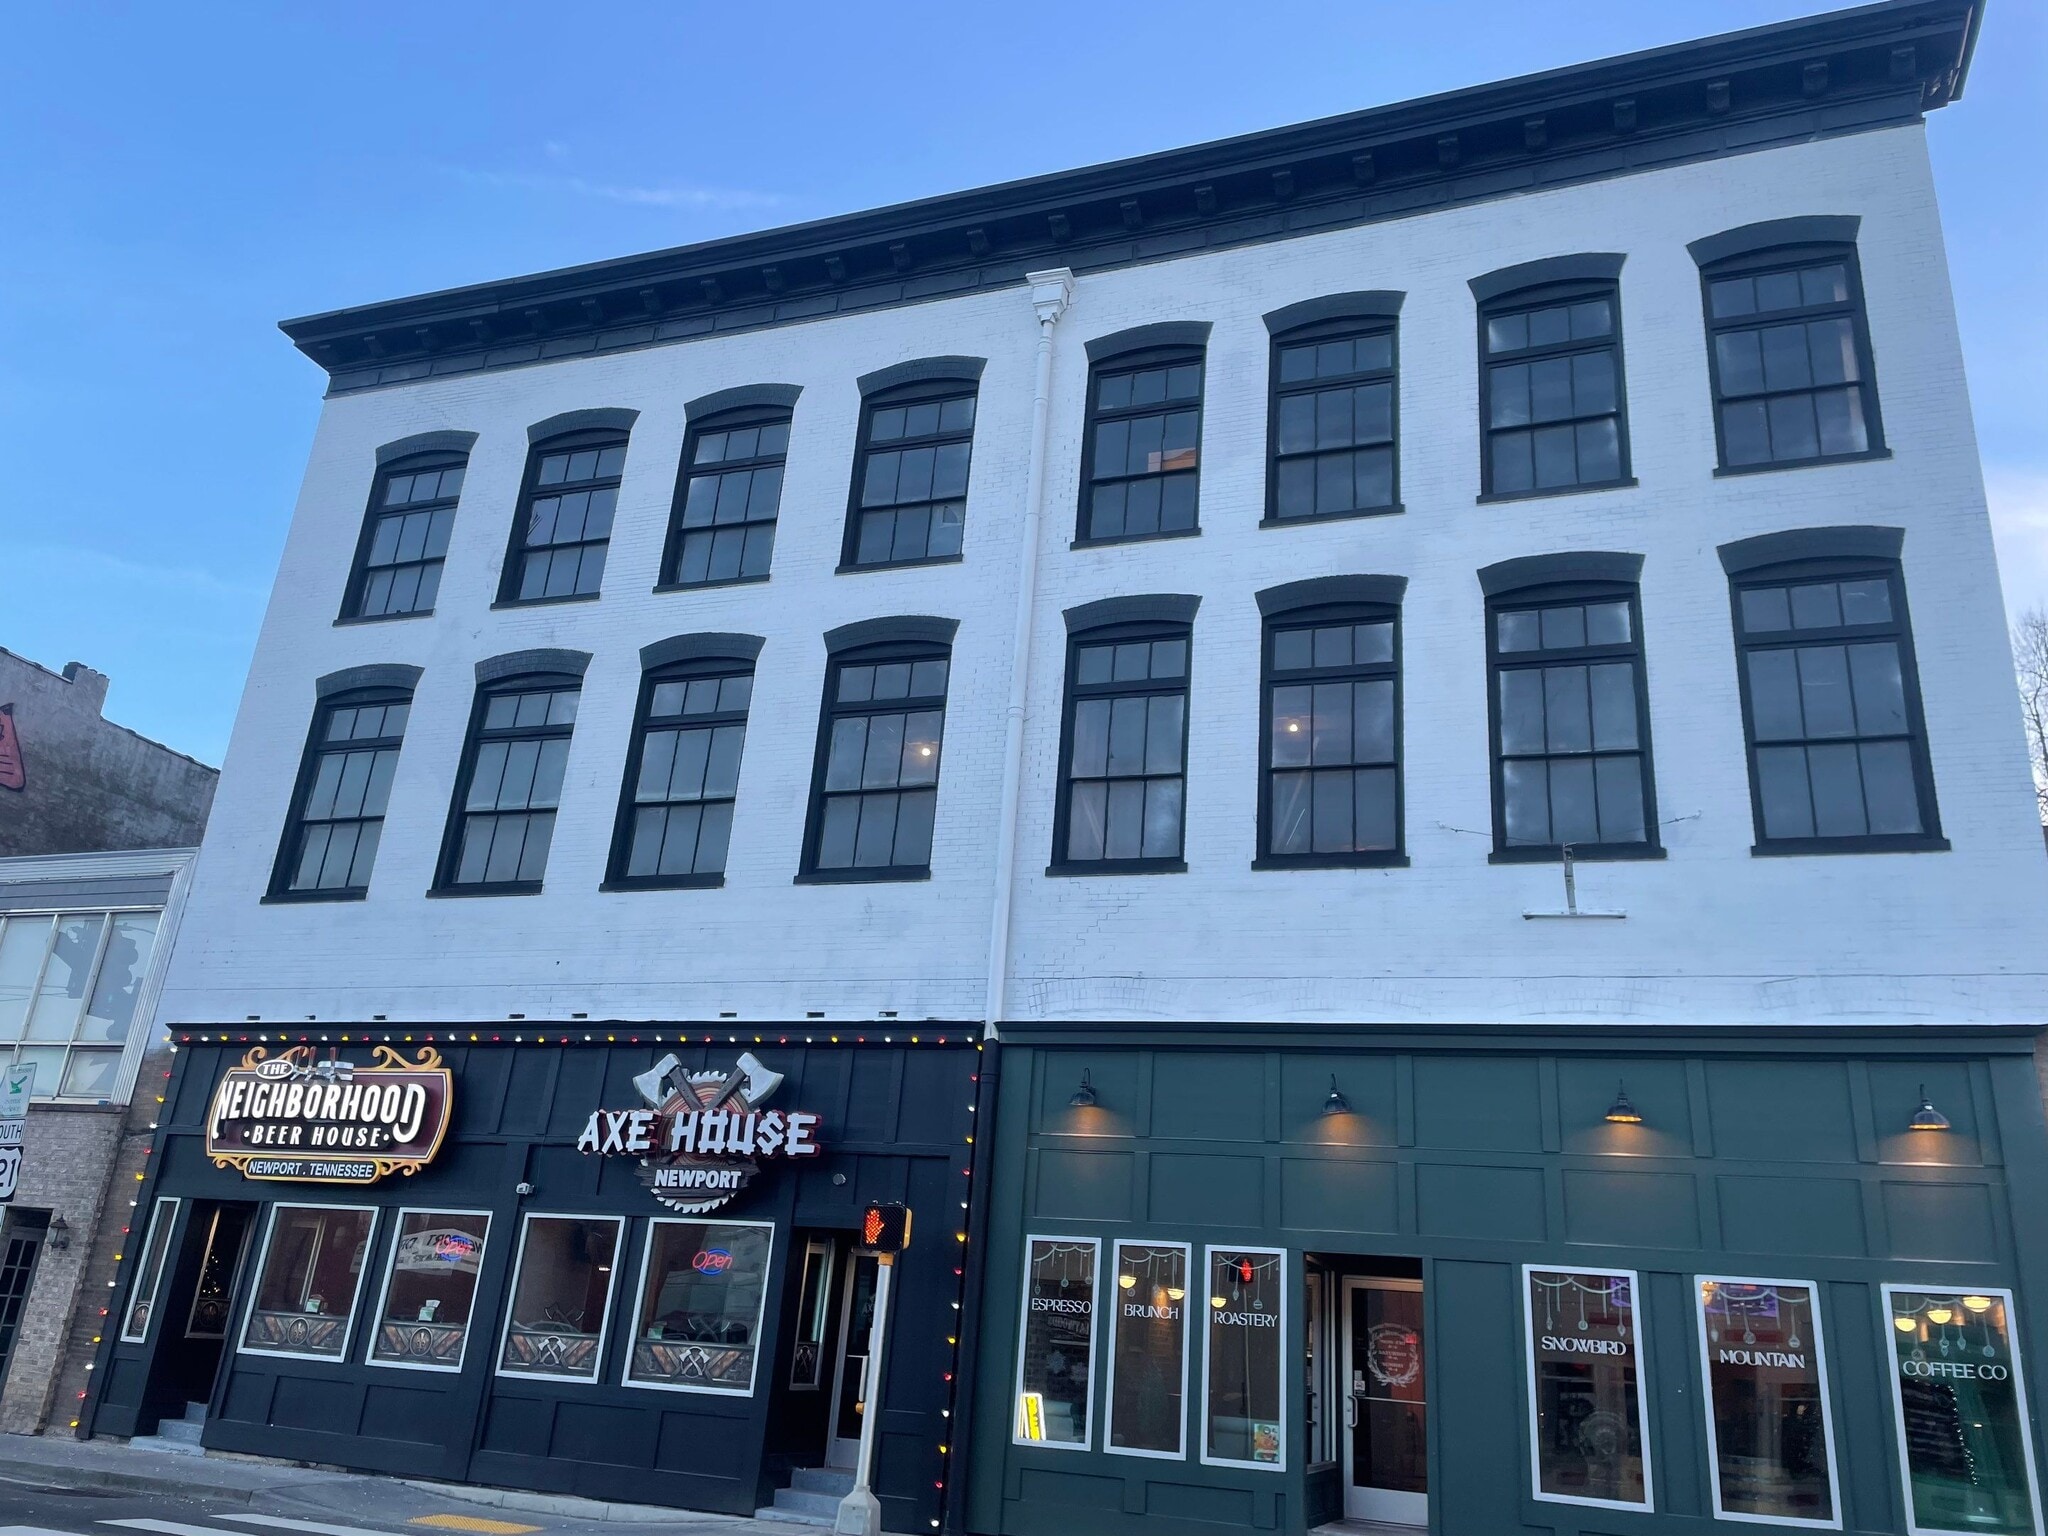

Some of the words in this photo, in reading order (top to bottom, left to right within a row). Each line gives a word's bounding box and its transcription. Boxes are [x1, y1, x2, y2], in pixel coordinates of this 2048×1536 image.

[263, 1064, 289, 1075] THE
[212, 1081, 426, 1143] NEIGHBORHOOD
[0, 1124, 23, 1139] OUTH
[252, 1125, 302, 1145] BEER
[311, 1126, 381, 1147] HOUSE
[577, 1110, 654, 1153] AXE
[671, 1109, 818, 1156] HOUSE
[249, 1161, 302, 1175] NEWPORT
[310, 1163, 373, 1177] TENNESSEE
[654, 1169, 742, 1188] NEWPORT
[692, 1251, 733, 1270] Open
[1031, 1298, 1092, 1314] ESPRESSO
[1124, 1304, 1179, 1320] BRUNCH
[1214, 1311, 1278, 1328] ROASTERY
[1541, 1336, 1627, 1356] SNOWBIRD
[1719, 1350, 1805, 1369] MOUNTAIN
[1902, 1361, 1977, 1379] COFFEE
[1978, 1364, 2008, 1380] CO
